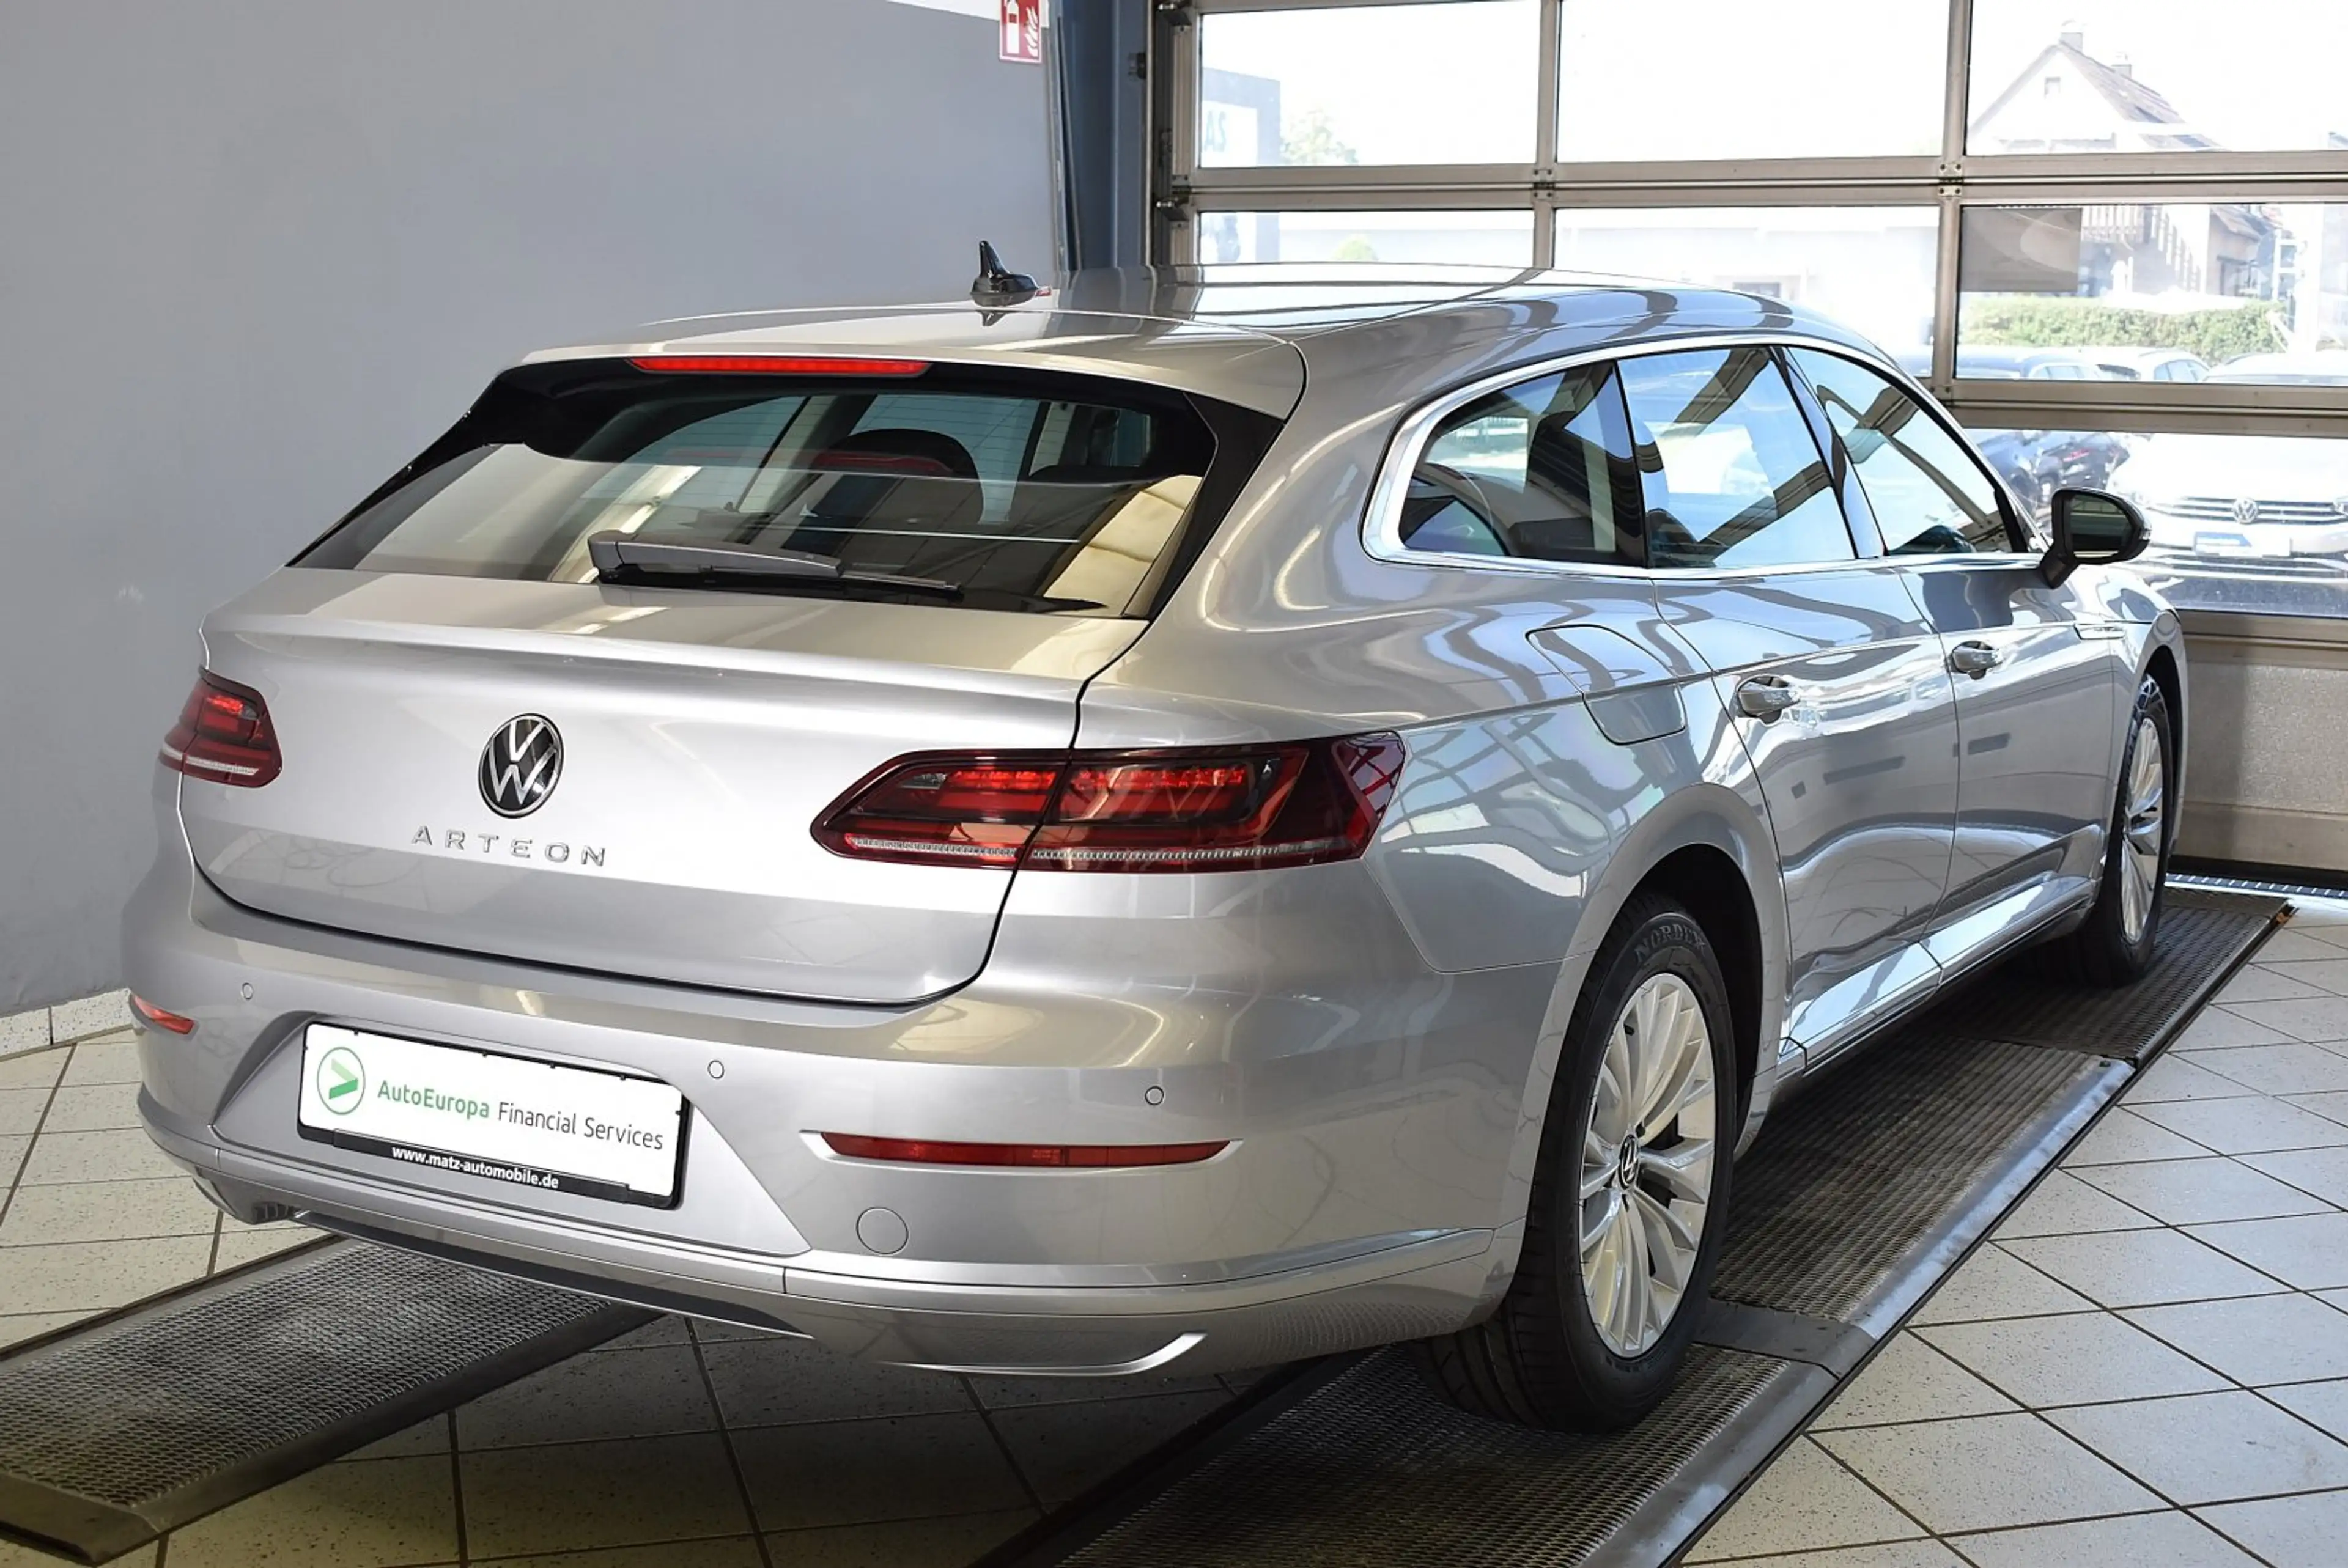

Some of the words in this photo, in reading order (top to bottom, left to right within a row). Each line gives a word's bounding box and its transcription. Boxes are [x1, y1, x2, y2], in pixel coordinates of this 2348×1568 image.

[412, 825, 606, 867] ARTEON
[377, 1080, 490, 1120] AutoEuropa
[498, 1102, 577, 1135] Financial
[583, 1117, 664, 1151] Services
[392, 1146, 559, 1190] www.matz-automobile.de
